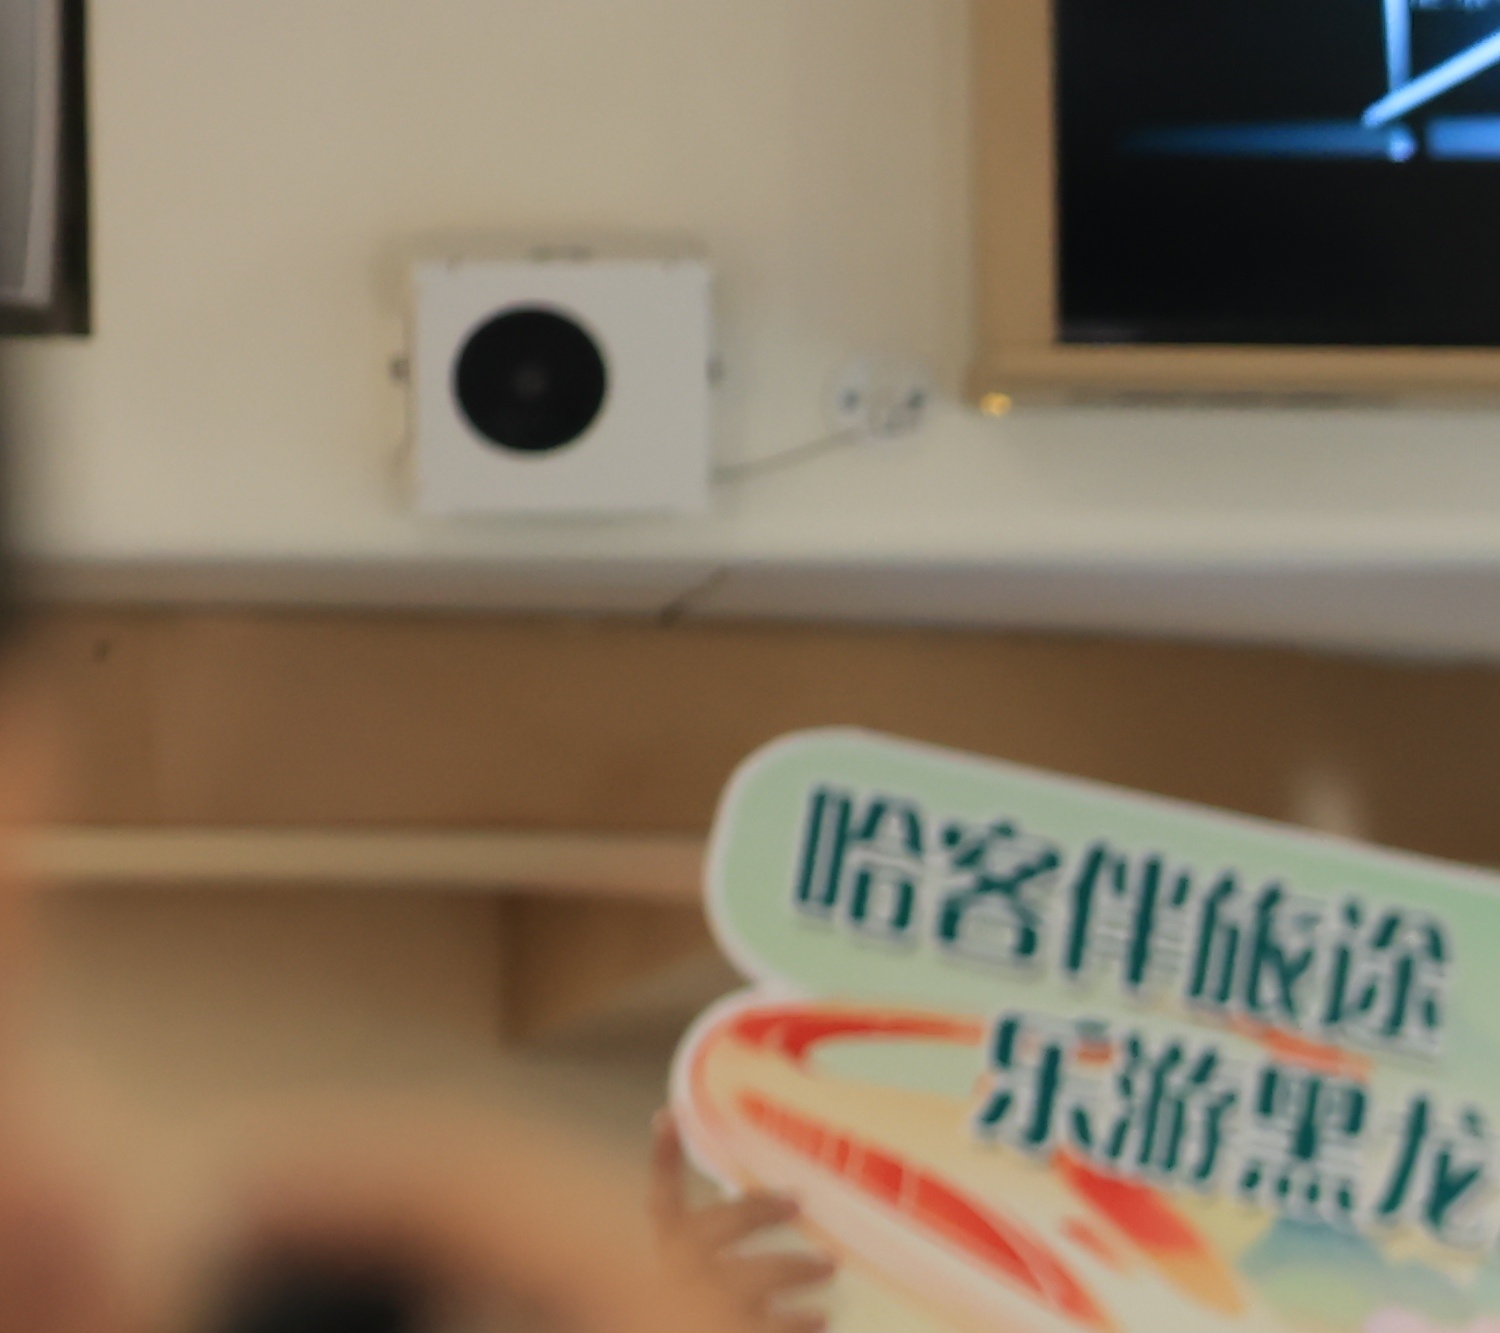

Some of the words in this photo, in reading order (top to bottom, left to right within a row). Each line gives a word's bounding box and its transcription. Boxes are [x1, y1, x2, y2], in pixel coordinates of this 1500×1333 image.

[795, 783, 1450, 1046] 哈客伴旅途
